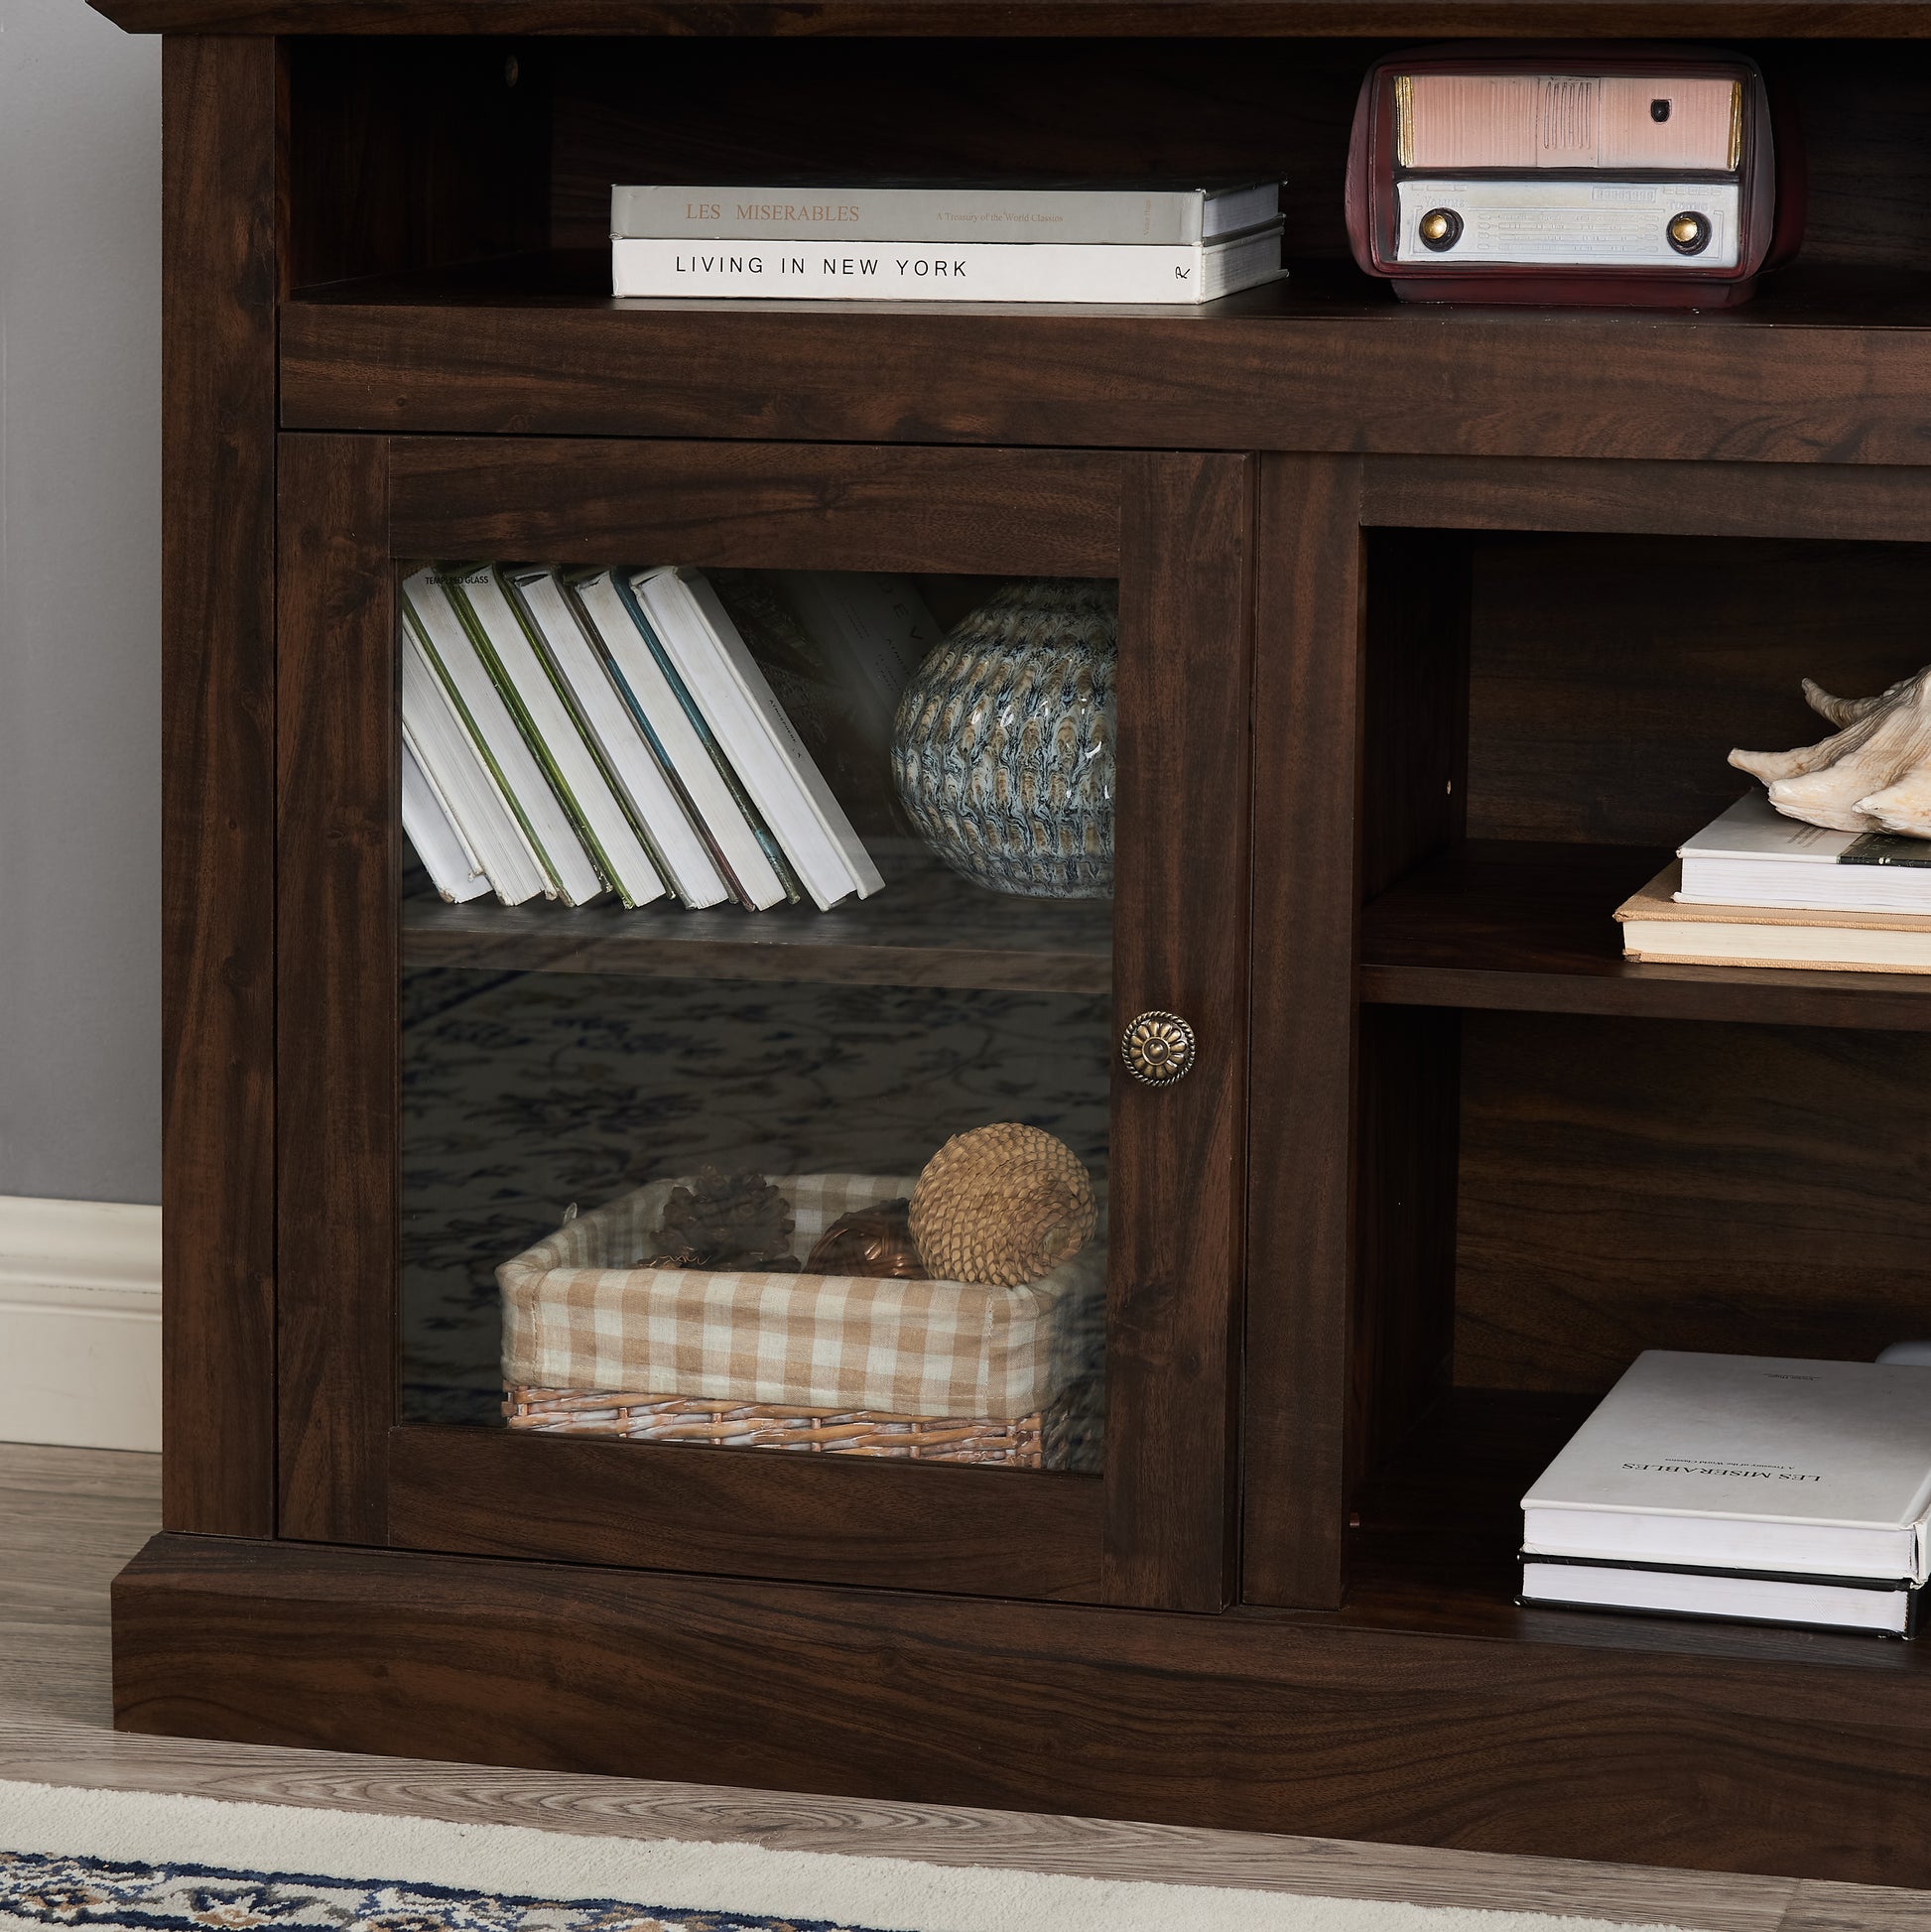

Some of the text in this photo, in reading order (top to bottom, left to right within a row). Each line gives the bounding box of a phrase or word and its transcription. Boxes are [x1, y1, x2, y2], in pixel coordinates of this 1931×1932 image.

[686, 203, 859, 222] LES MISERABLES
[945, 212, 978, 223] Treasury
[980, 212, 990, 222] of
[991, 213, 1003, 222] the
[1005, 213, 1030, 223] World
[676, 256, 967, 277] LIVING IN NEW YORK
[464, 576, 489, 584] GLASS
[1621, 1463, 1822, 1482] LES MISERABLES
